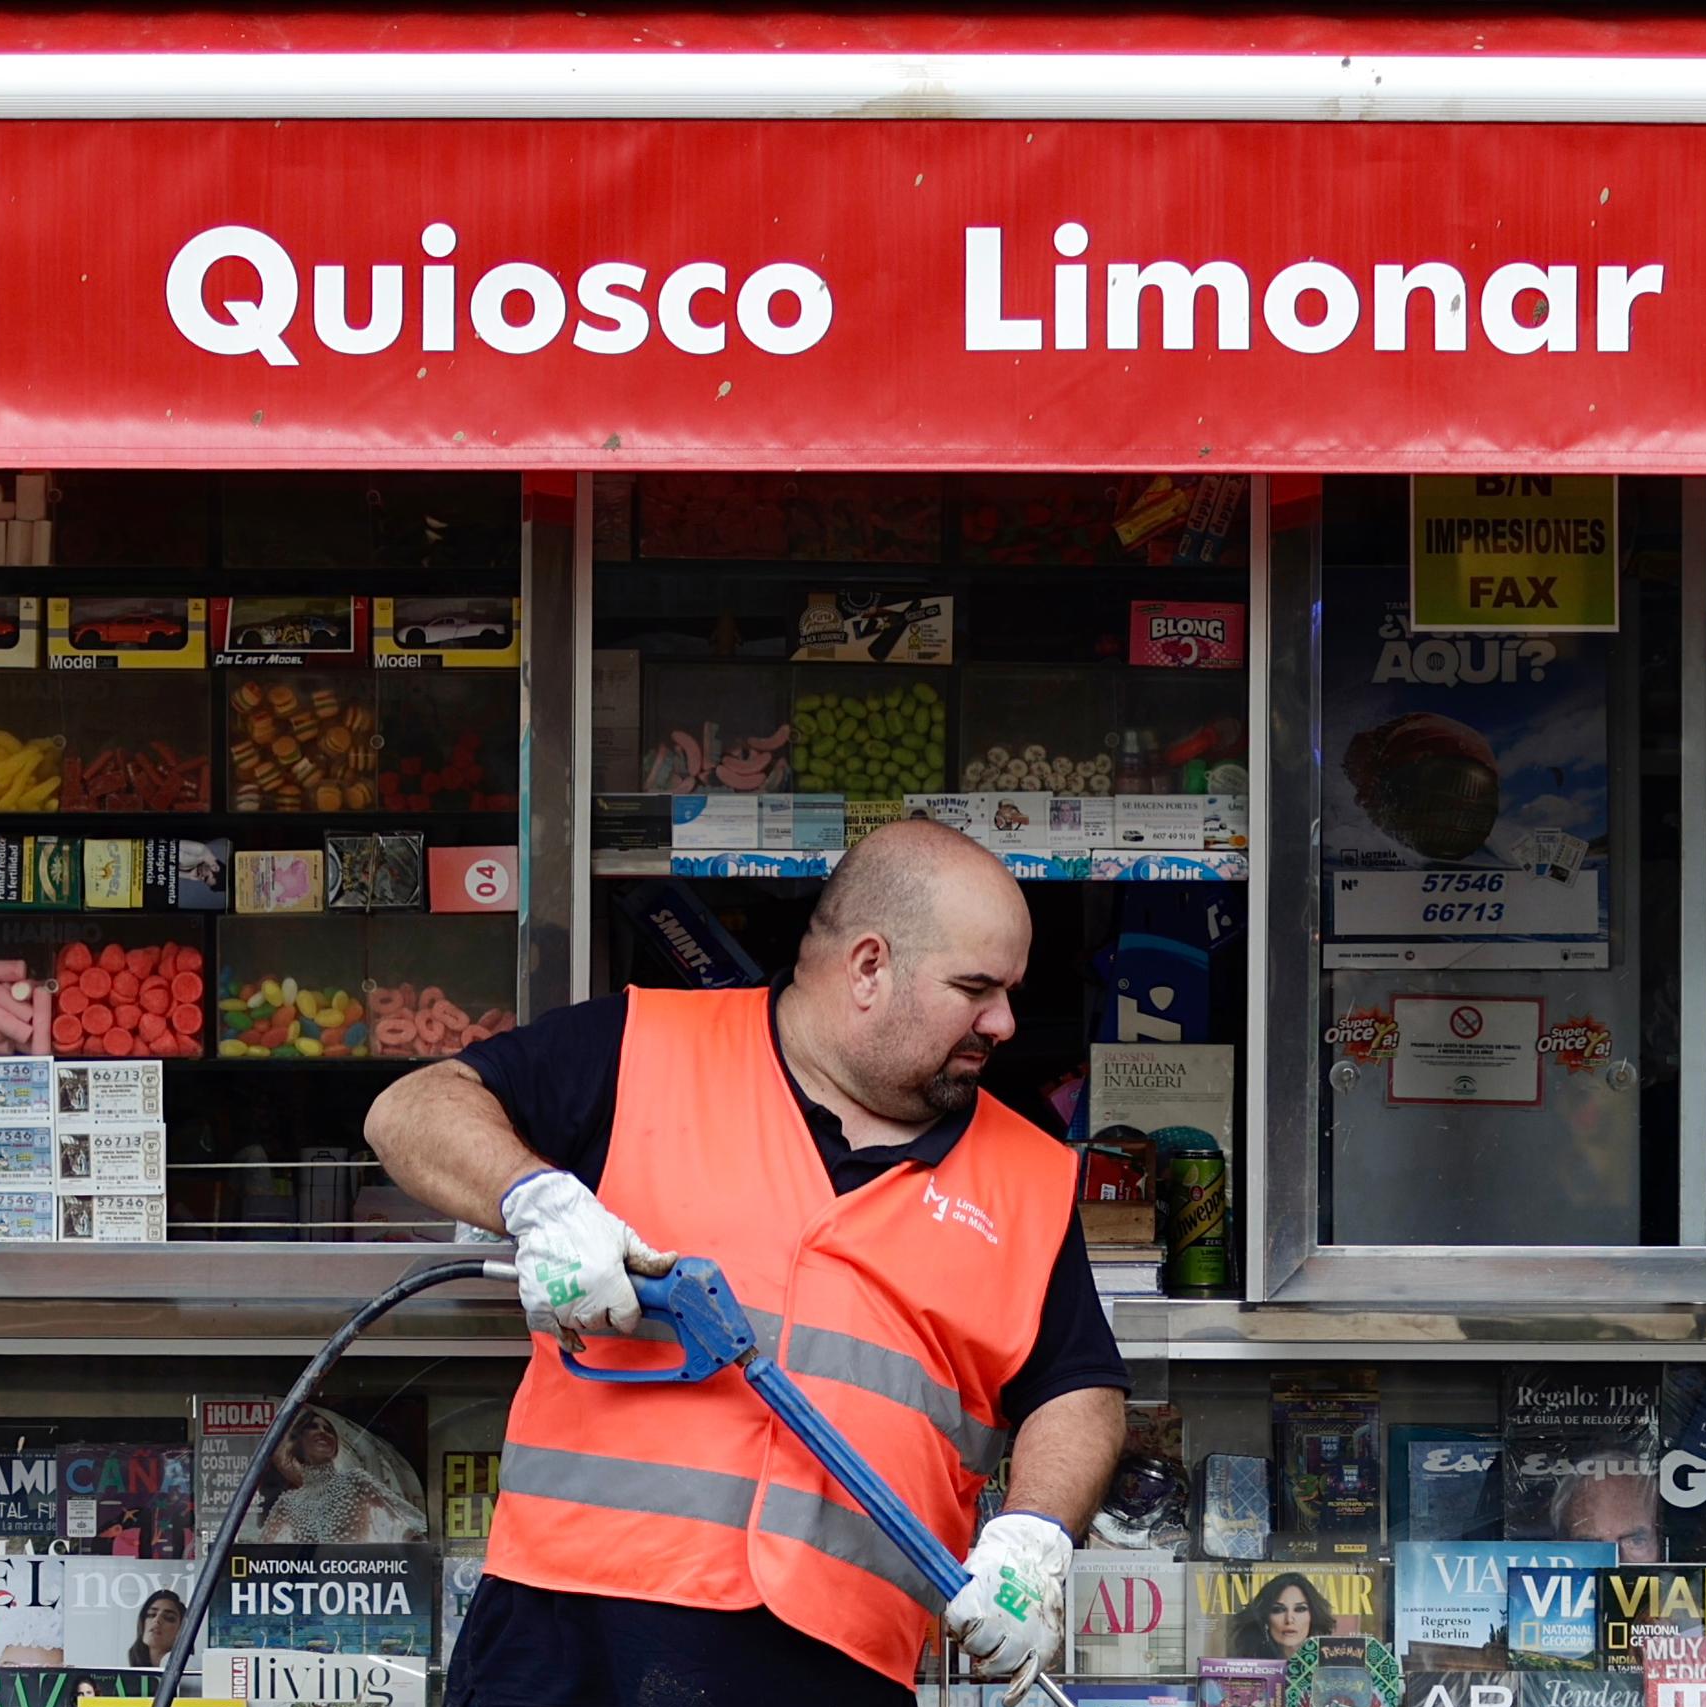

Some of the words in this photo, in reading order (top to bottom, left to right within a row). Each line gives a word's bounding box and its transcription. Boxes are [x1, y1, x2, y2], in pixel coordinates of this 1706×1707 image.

[164, 222, 834, 368] Quiosco
[964, 221, 1664, 354] Limonar
[1475, 474, 1553, 497] B/N
[1425, 518, 1606, 555] IMPRESIONES
[1469, 576, 1558, 609] FAX
[1150, 617, 1224, 643] BLONG
[48, 654, 96, 670] Model
[374, 653, 422, 669] Model
[8, 844, 19, 887] fertilidad
[1422, 873, 1505, 892] 57546
[1423, 903, 1505, 922] 66713
[1338, 1017, 1376, 1031] Super
[1324, 1026, 1373, 1044] Once
[1550, 1026, 1586, 1039] Super
[1536, 1036, 1584, 1055] Once
[93, 1070, 140, 1081] 66713
[1104, 1063, 1186, 1075] L'ITALIANA
[1104, 1075, 1121, 1088] IN
[1127, 1075, 1182, 1088] ALGERI
[94, 1136, 142, 1147] 66713
[97, 1197, 144, 1208] 57546
[956, 1198, 994, 1229] Limpieza
[953, 1210, 966, 1222] de
[968, 1217, 998, 1244] Málaga
[1517, 1386, 1600, 1410] Regalo:
[1605, 1386, 1647, 1407] The
[206, 1405, 272, 1425] ¡HOLA!
[1517, 1416, 1531, 1425] LA
[1535, 1415, 1561, 1425] GUÍA
[1565, 1416, 1578, 1425] DE
[1582, 1416, 1631, 1425] RELOJES
[201, 1440, 229, 1452] ALTA
[15, 1522, 43, 1530] marca
[249, 1560, 317, 1574] NATIONAL
[320, 1560, 408, 1574] GEOGRAPHIC
[231, 1581, 412, 1615] HISTORIA
[1081, 1575, 1163, 1634] AD
[1420, 1615, 1471, 1628] Regreso
[1542, 1623, 1592, 1635] NATIONAL
[1432, 1628, 1470, 1640] Berlín
[1608, 1656, 1637, 1664] INDIA
[1201, 1666, 1253, 1675] PLATINUM
[254, 1657, 394, 1707] living
